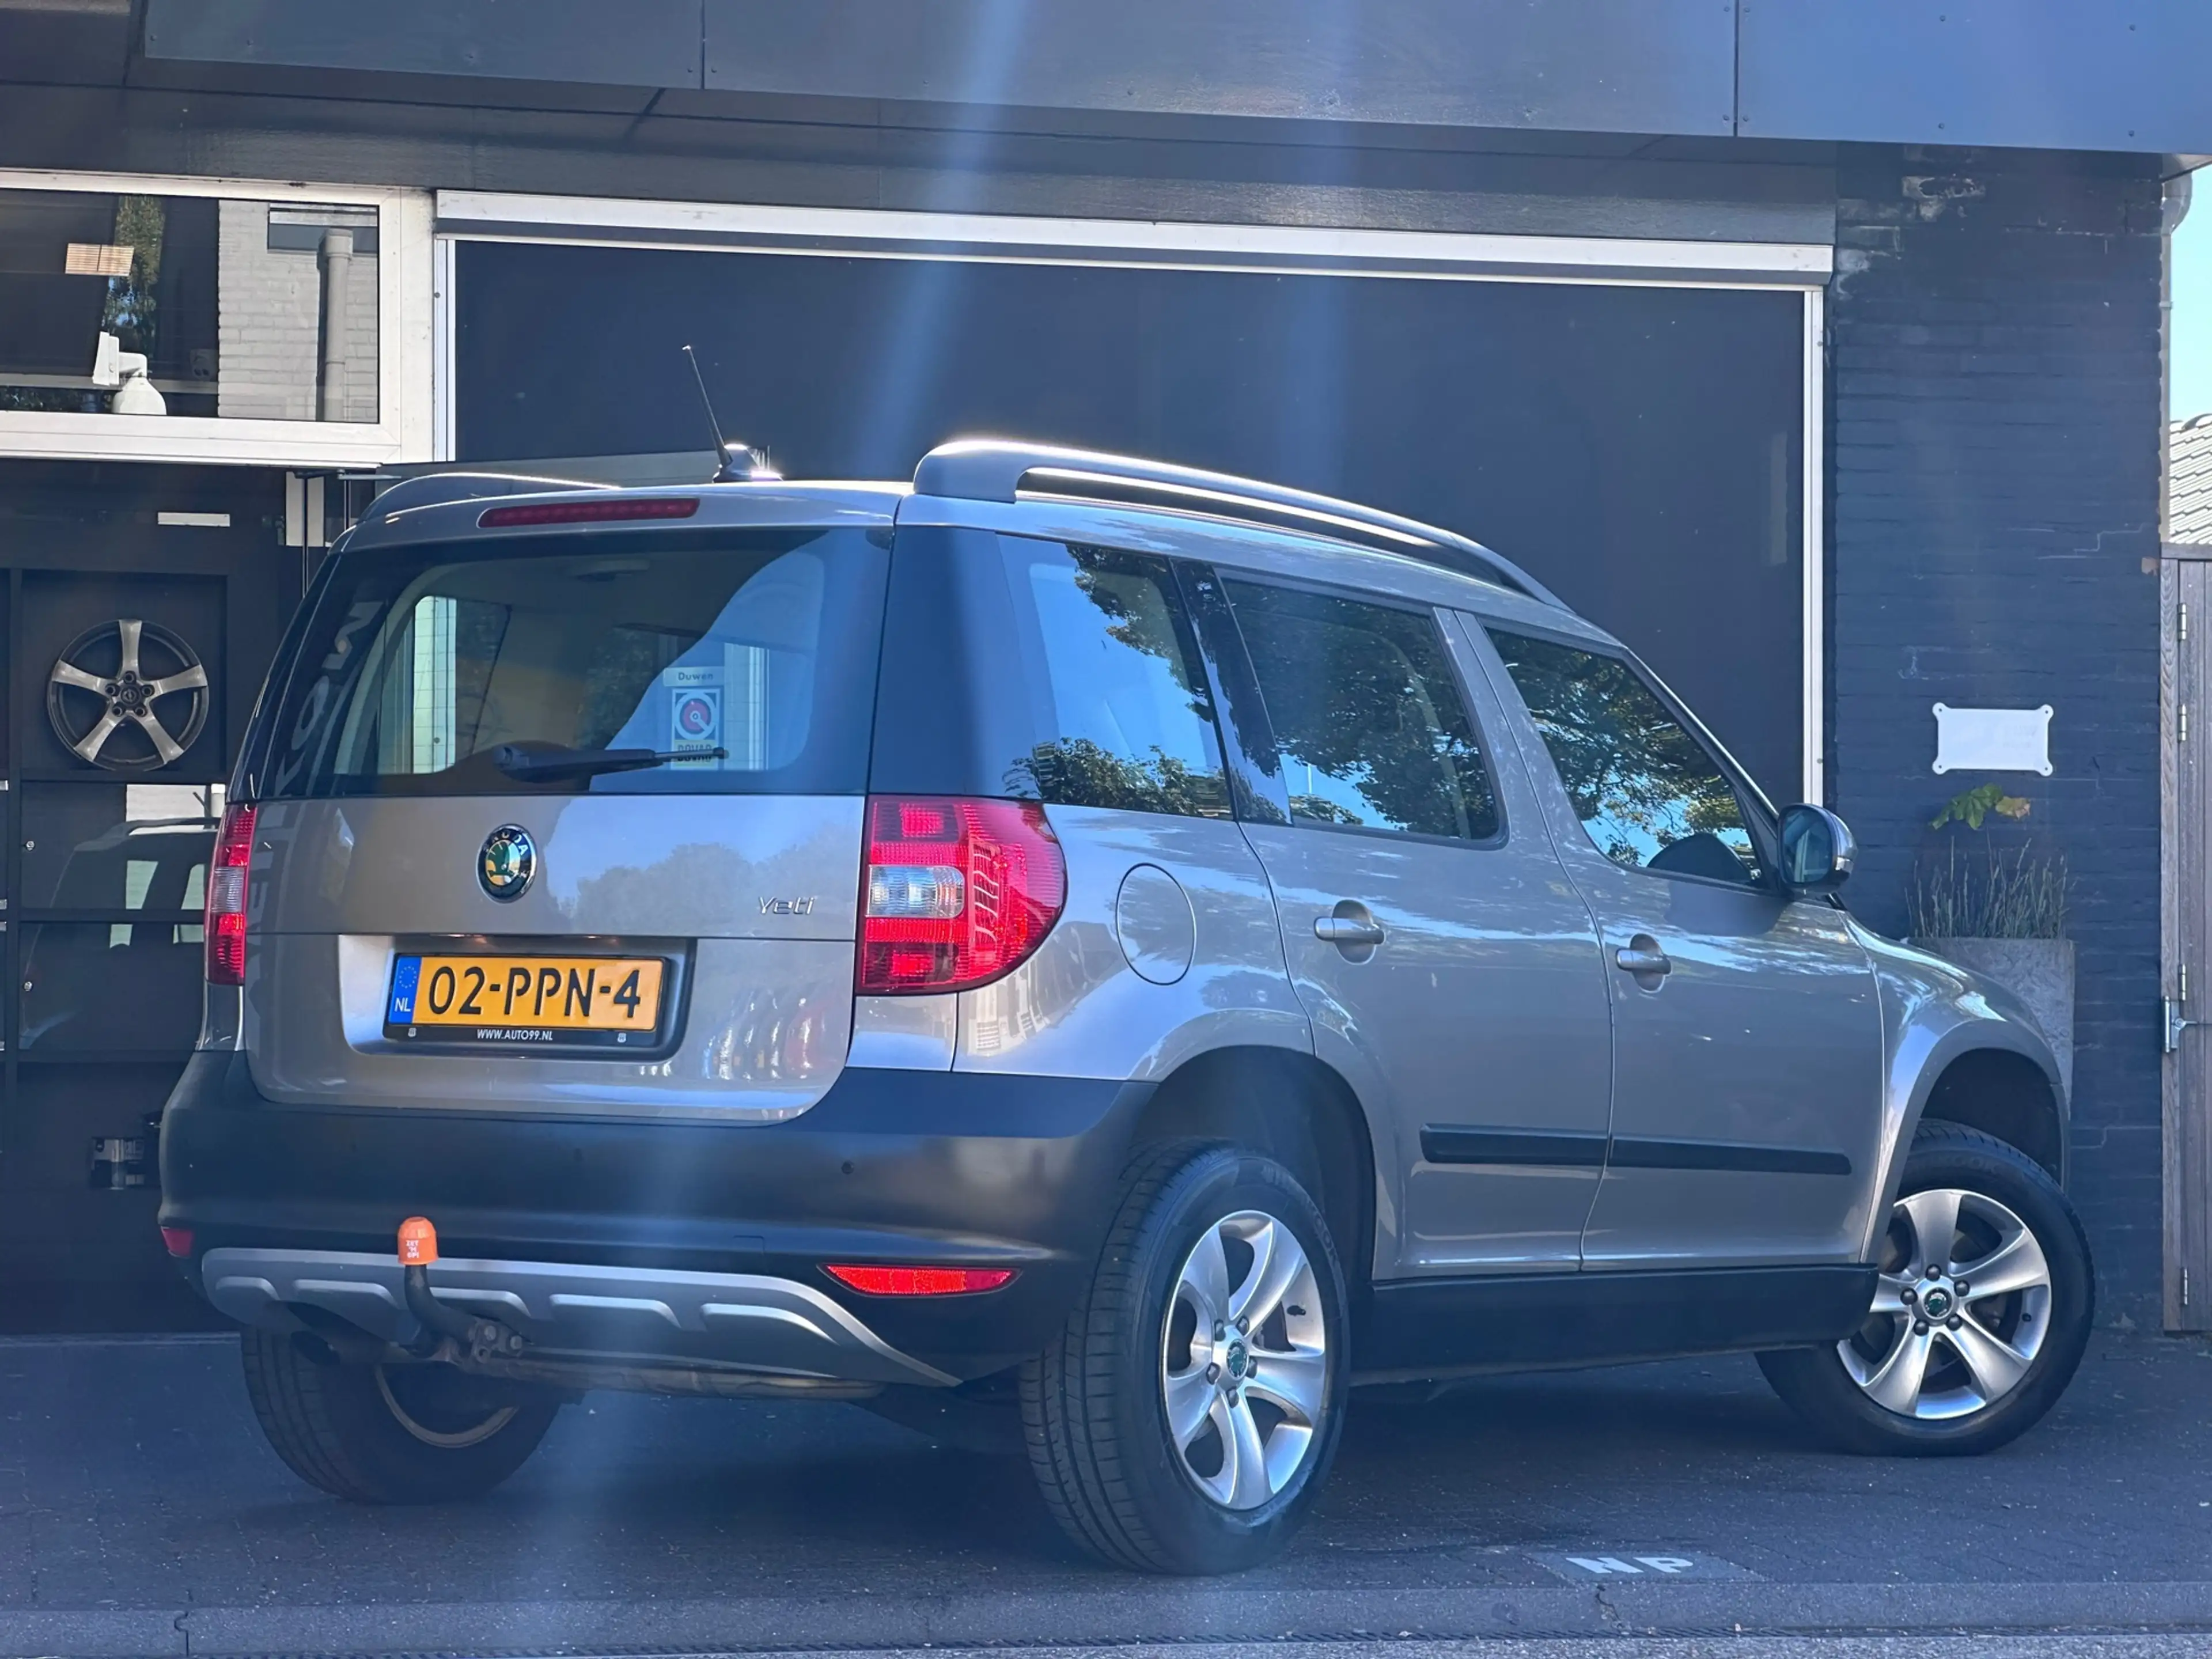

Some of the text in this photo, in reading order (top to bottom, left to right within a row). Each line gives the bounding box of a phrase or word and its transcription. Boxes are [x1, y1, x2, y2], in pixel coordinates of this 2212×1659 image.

[678, 672, 714, 681] Duwen
[757, 896, 814, 915] Yeti
[429, 965, 641, 1018] 02-PPN-4
[394, 997, 411, 1012] NL
[476, 1028, 553, 1041] WWW.AUTO99.NL
